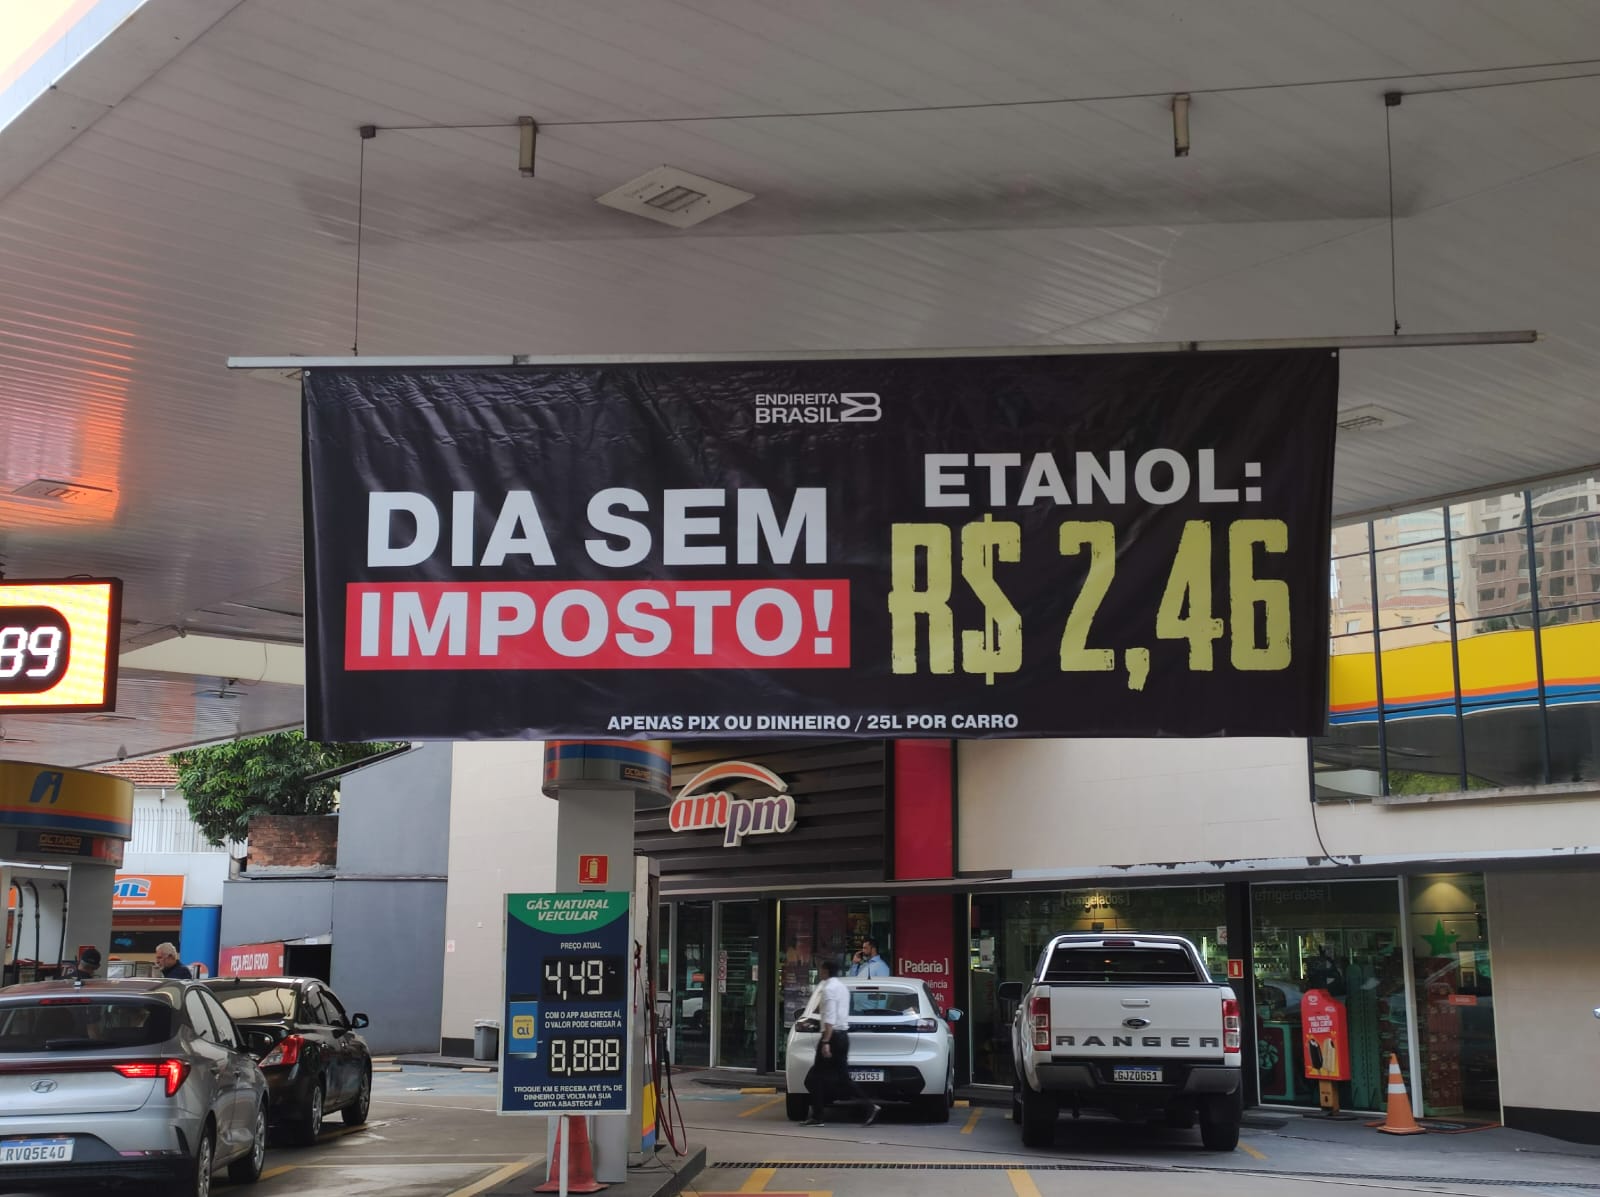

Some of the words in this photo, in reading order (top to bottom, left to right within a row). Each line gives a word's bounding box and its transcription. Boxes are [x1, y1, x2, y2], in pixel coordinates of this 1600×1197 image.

[755, 393, 839, 406] ENDIREITA
[755, 406, 840, 424] BRASIL
[924, 447, 1262, 508] ETANOL:
[366, 489, 557, 568] DIA
[584, 486, 828, 568] SEM
[888, 513, 1023, 686] R$
[1059, 518, 1292, 692] 2,46
[360, 587, 834, 659] IMPOSTO!
[607, 715, 684, 730] APENAS
[688, 715, 720, 730] PIX
[724, 715, 752, 730] OU
[756, 714, 851, 730] DINHEIRO
[866, 714, 902, 729] 25L
[906, 714, 947, 729] POR
[951, 714, 1019, 729] CARRO
[669, 791, 797, 847] ampm
[526, 898, 551, 911] GÁS
[553, 898, 609, 910] NATURAL
[537, 910, 599, 921] VEICULAR
[560, 942, 582, 951] PREÇO
[582, 941, 603, 950] ATUAL
[545, 960, 603, 1001] 4,49
[545, 1011, 559, 1019] COM
[560, 1011, 566, 1019] O
[566, 1011, 579, 1019] APP
[580, 1010, 613, 1019] ABASTECE
[545, 1020, 551, 1029] O
[551, 1020, 572, 1029] VALOR
[572, 1020, 589, 1028] PODE
[589, 1020, 617, 1028] CHEGAR
[617, 1020, 622, 1028] A
[1055, 1035, 1219, 1048] RANGER
[551, 1039, 619, 1077] 8,888
[594, 1099, 602, 1107] AÍ
[6, 1146, 66, 1161] RVQ5E40
